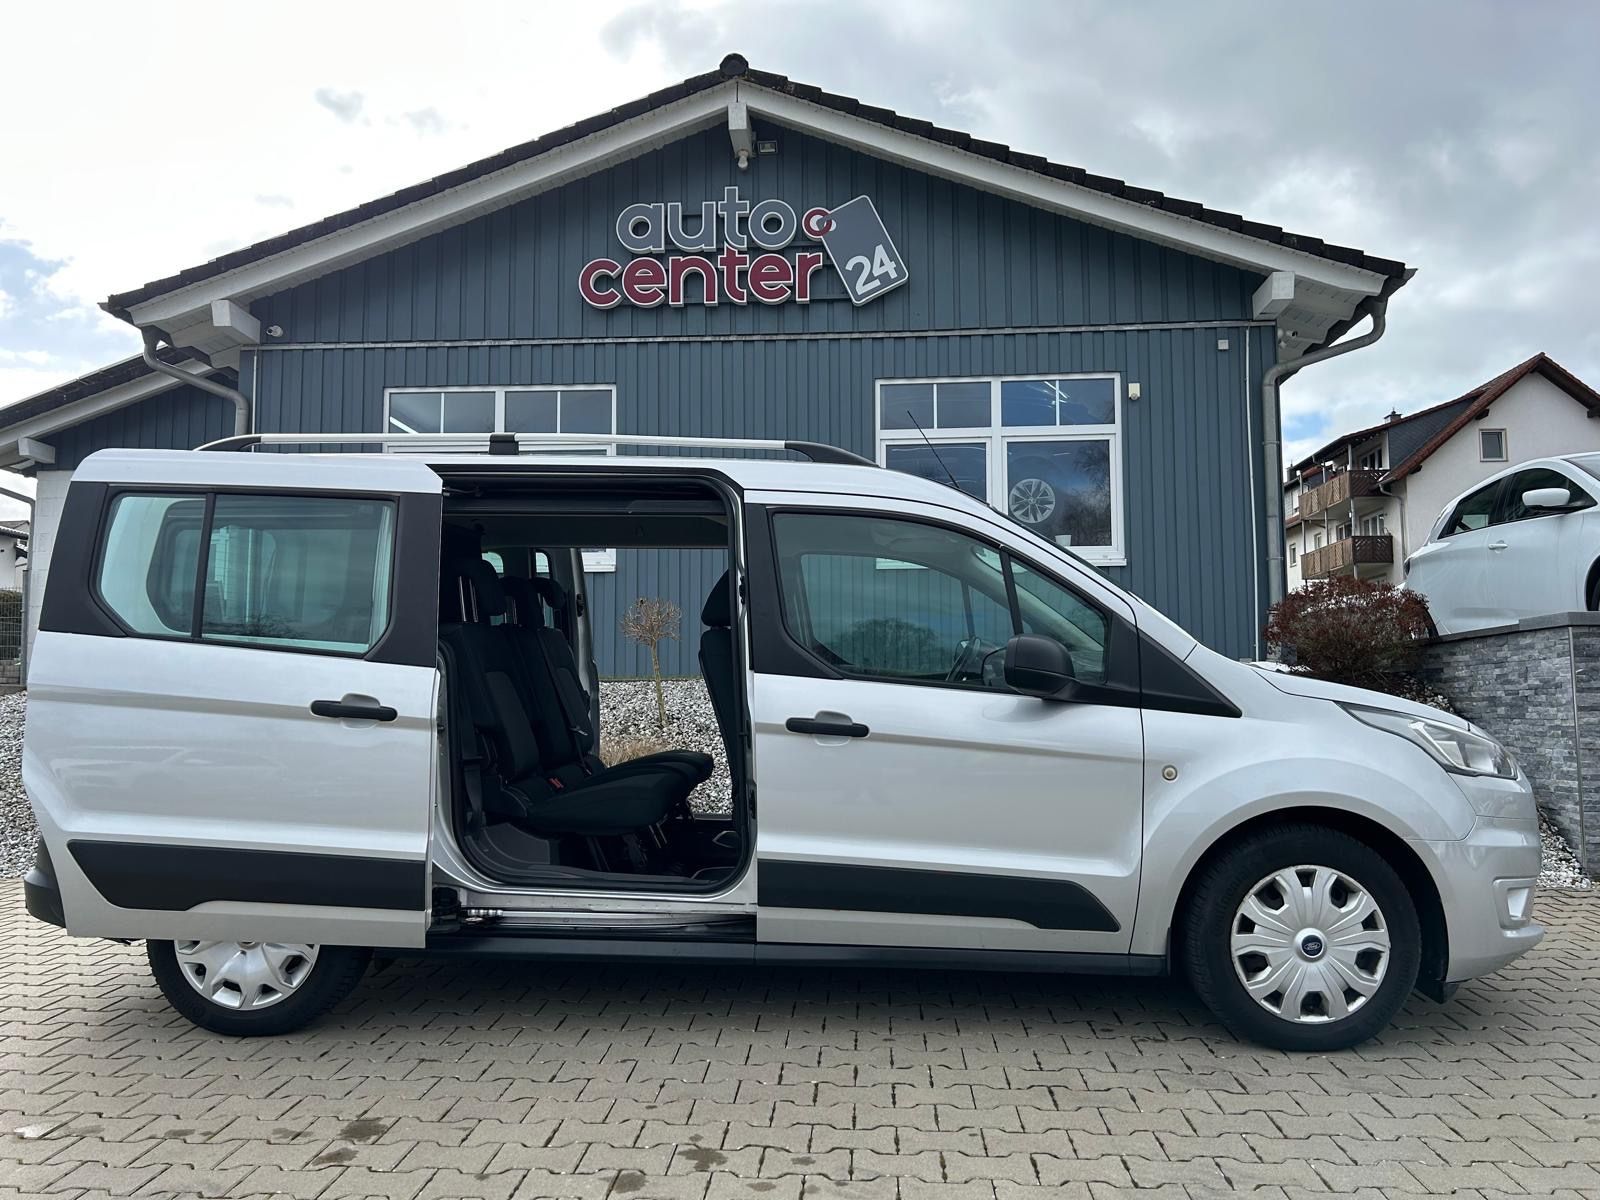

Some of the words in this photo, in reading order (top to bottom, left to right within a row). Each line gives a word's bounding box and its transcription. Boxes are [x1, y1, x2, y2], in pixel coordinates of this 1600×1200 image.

[616, 186, 797, 253] auto
[578, 241, 823, 308] center
[845, 244, 898, 295] 24
